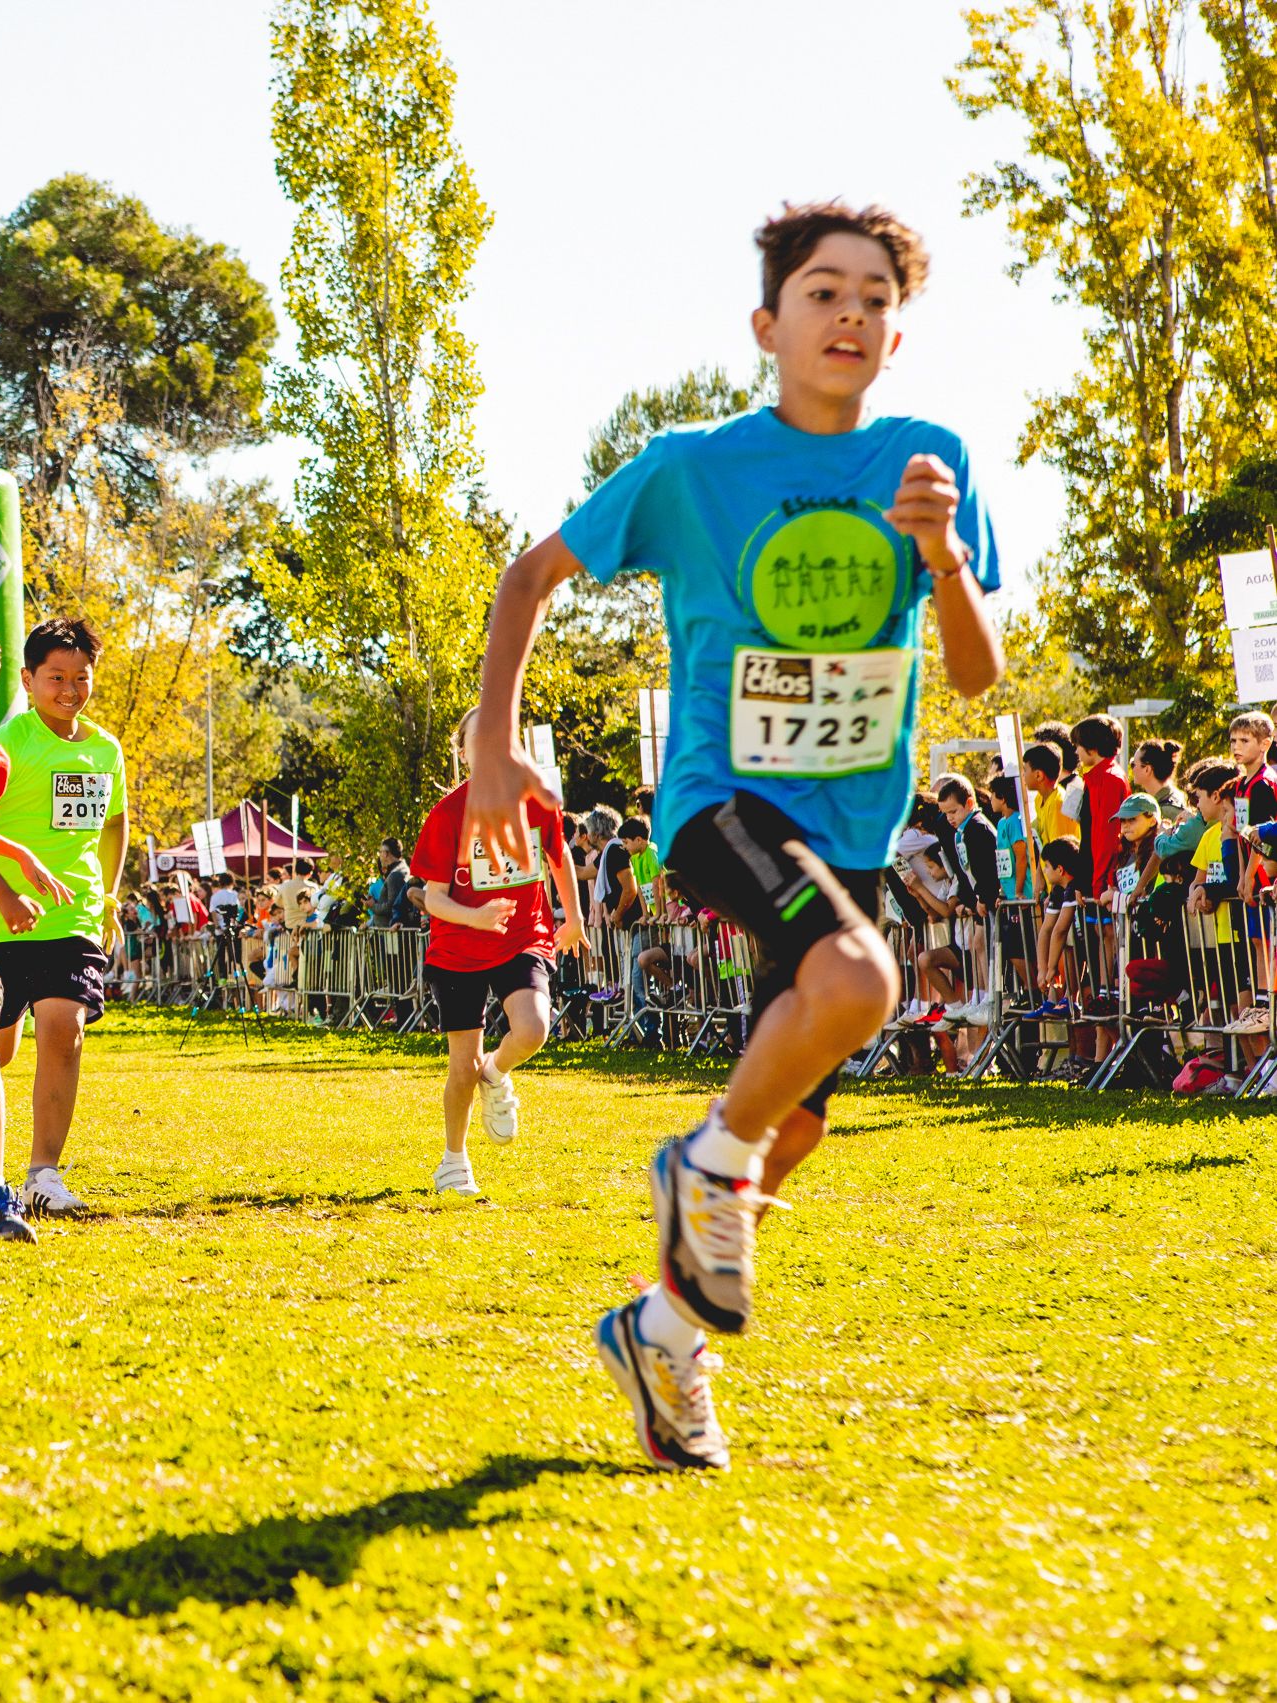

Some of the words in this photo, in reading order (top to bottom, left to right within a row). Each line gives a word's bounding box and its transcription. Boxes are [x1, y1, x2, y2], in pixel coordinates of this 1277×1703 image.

[745, 674, 811, 696] CROS
[759, 716, 869, 746] 1723
[57, 783, 82, 793] CROS
[62, 803, 106, 818] 2013
